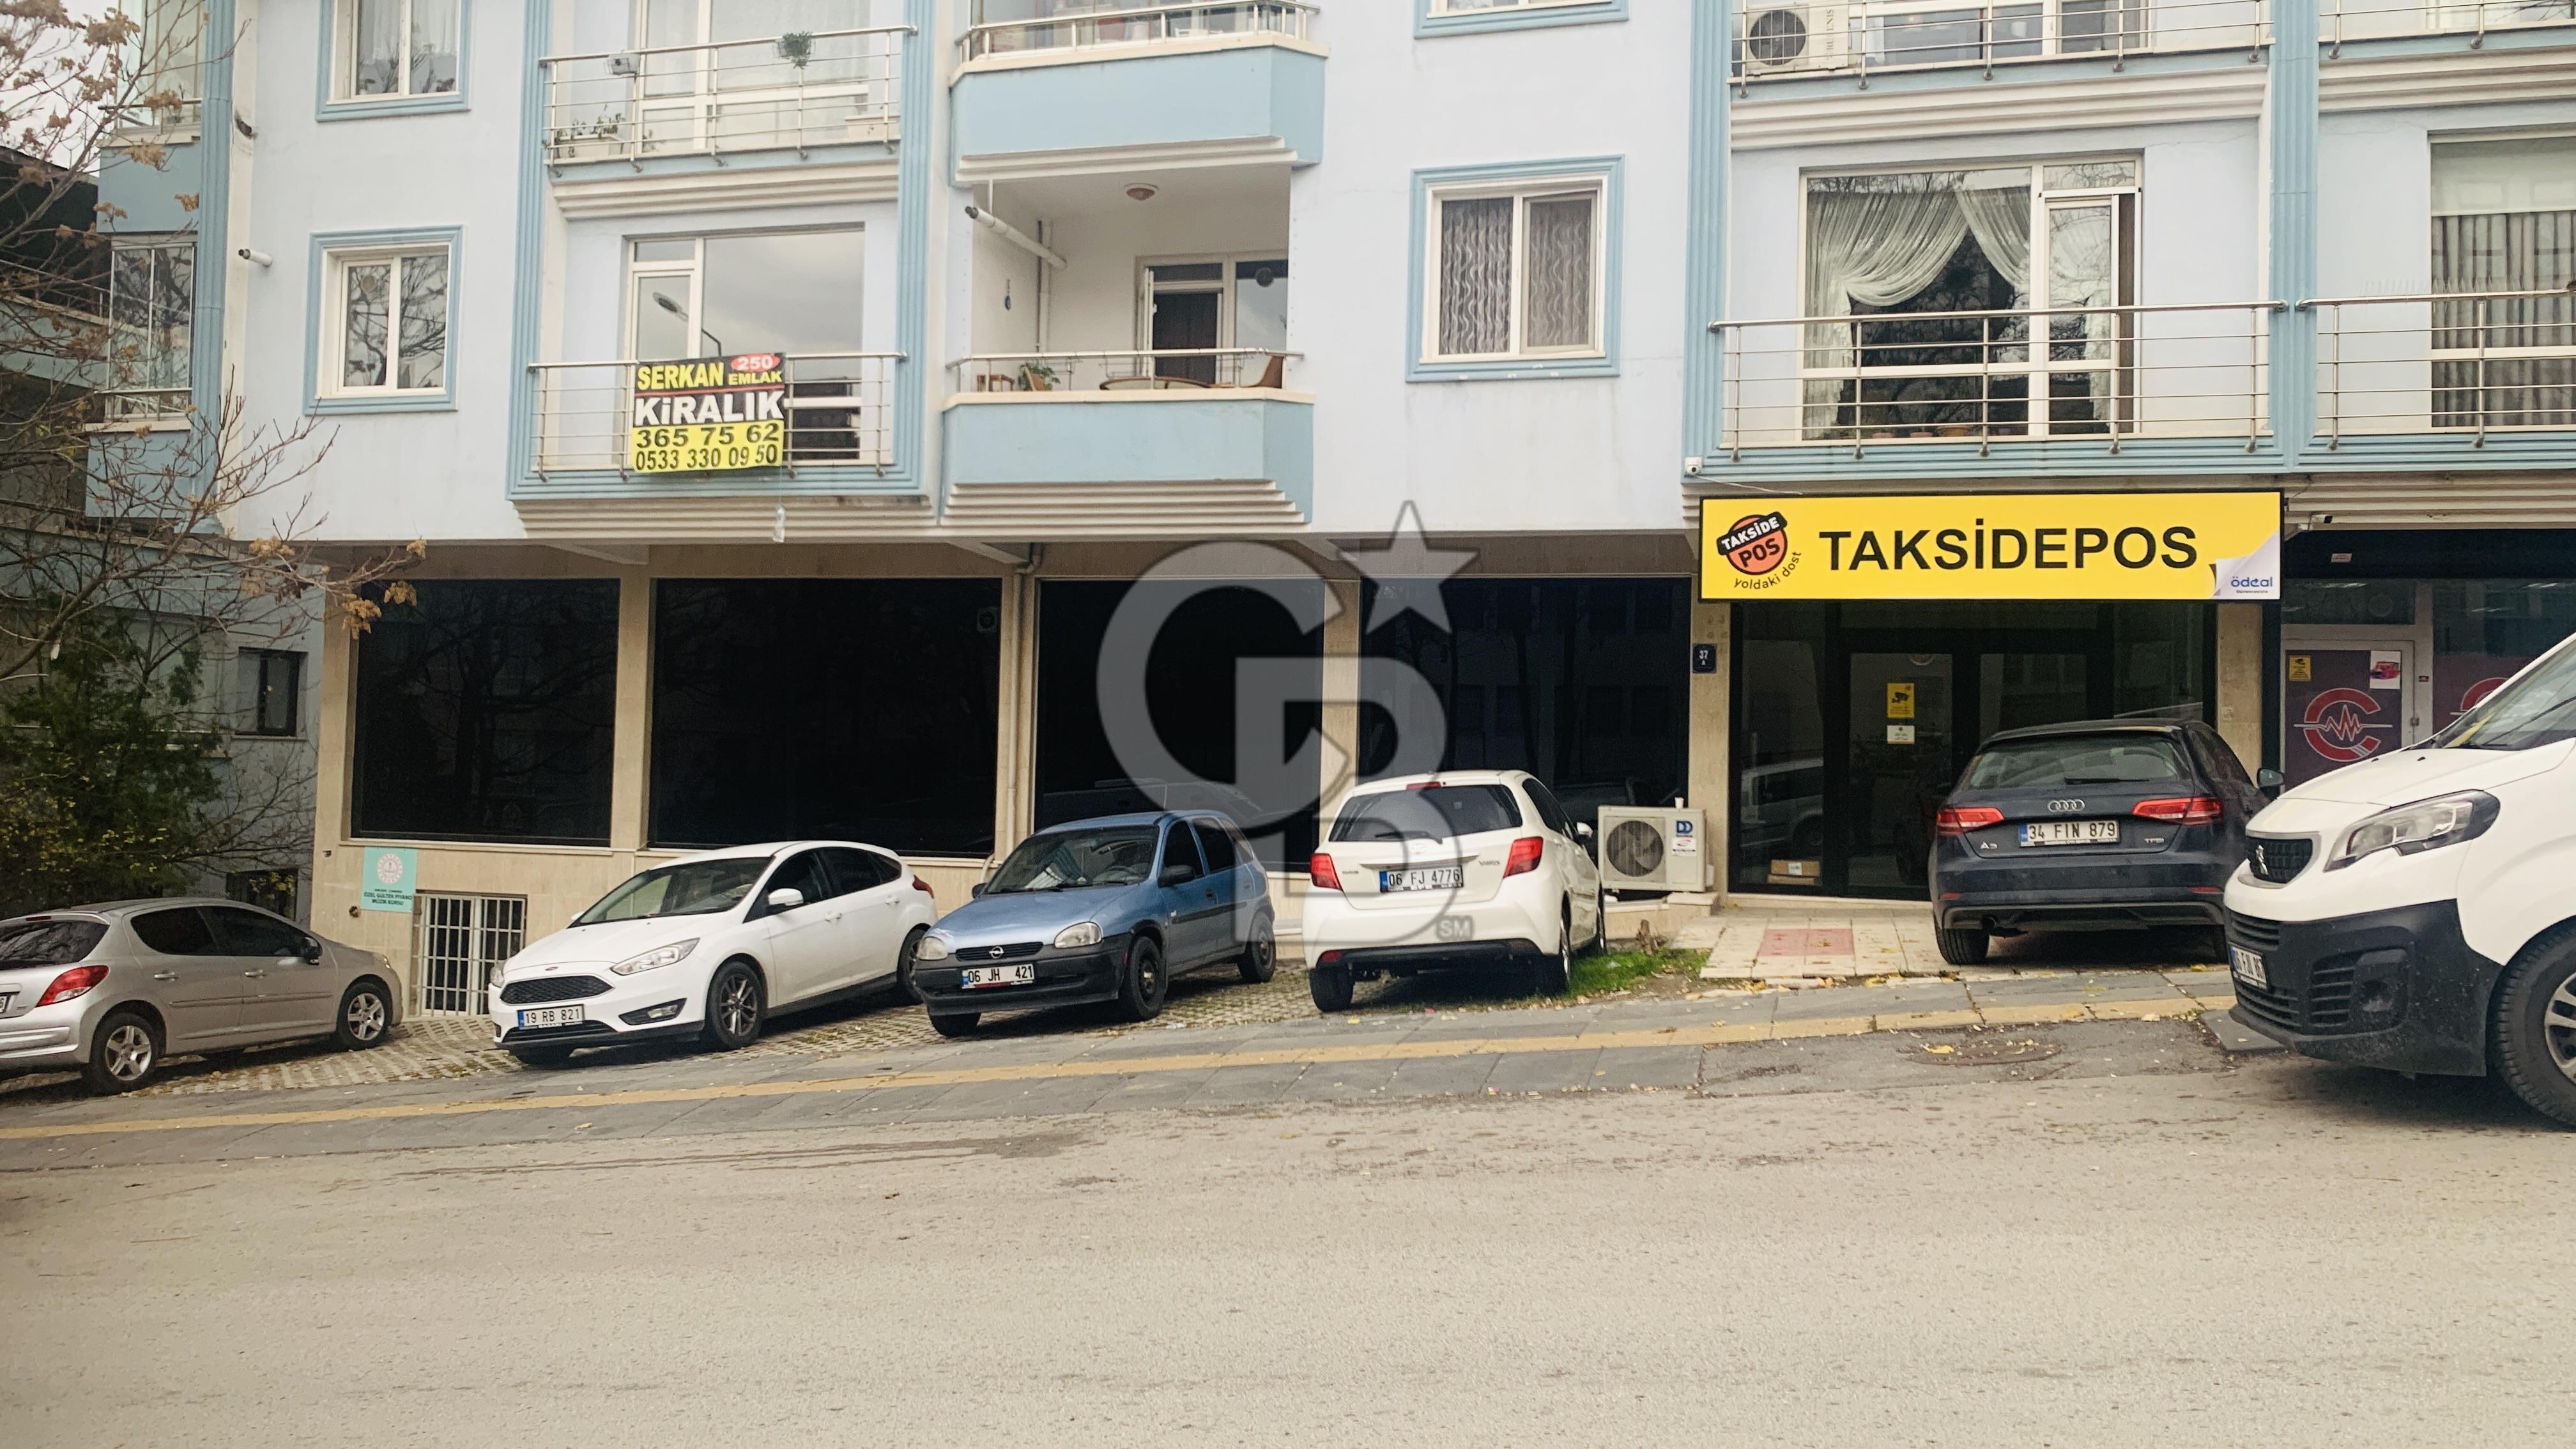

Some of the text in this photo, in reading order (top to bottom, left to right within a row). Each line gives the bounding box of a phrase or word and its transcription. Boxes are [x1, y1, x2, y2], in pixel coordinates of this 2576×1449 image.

[737, 356, 773, 369] 250
[637, 362, 783, 390] SERKAN EMLAK
[636, 422, 779, 448] 365 75 62
[636, 444, 778, 471] 0533 330 09 50
[1721, 516, 1780, 550] TAKSİDE
[1819, 518, 2198, 571] TAKSİDEPOS
[1738, 538, 1781, 568] POS
[1733, 551, 1802, 590] yoldaki dost
[2028, 822, 2115, 839] 34 FIN 879
[1389, 869, 1460, 887] 06 FJ 4776
[968, 965, 1033, 983] 06 JH 421
[526, 1008, 579, 1023] 19 RB 821
